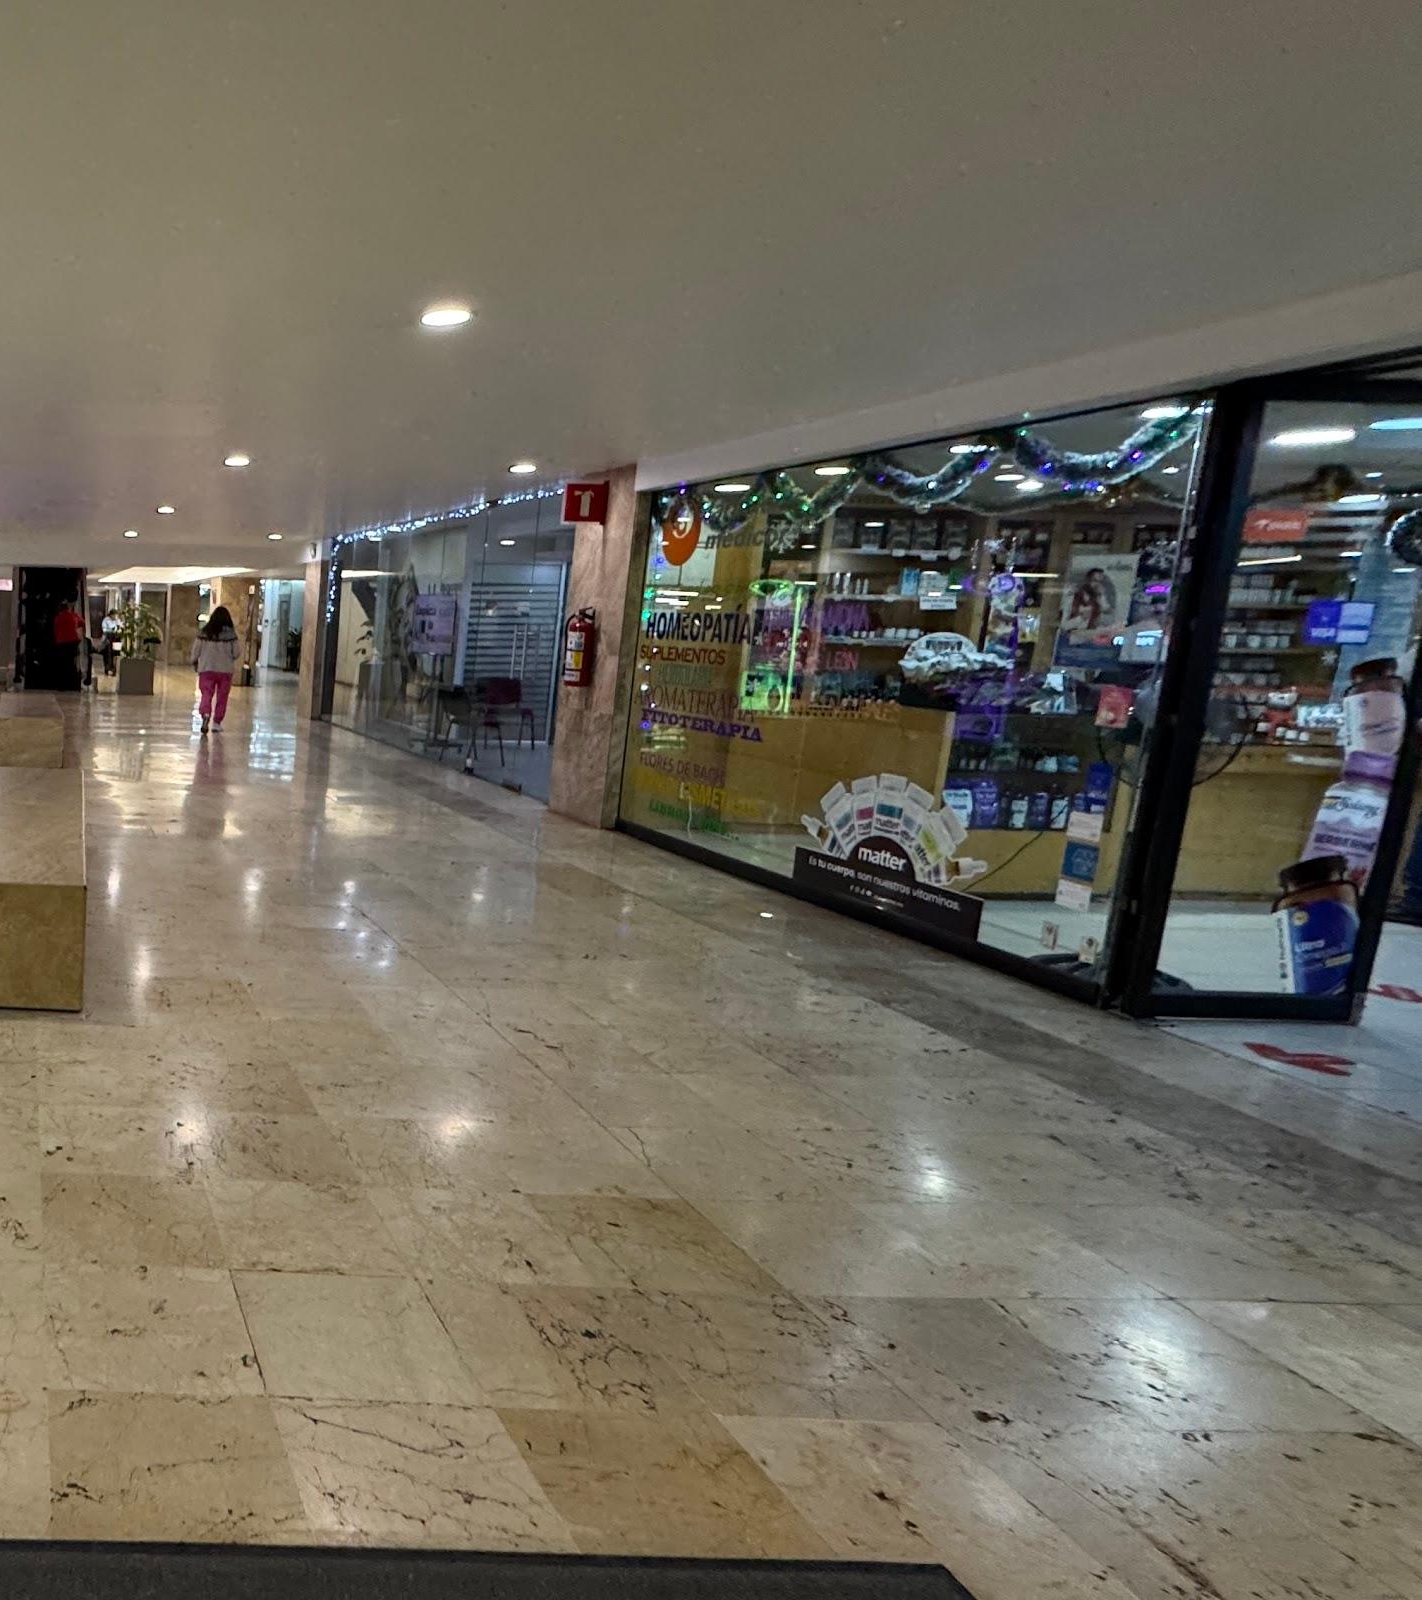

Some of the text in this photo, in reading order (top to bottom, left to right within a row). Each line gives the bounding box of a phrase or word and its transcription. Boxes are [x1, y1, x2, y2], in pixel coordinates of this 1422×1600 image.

[645, 604, 752, 644] HOMEOPATÍA
[640, 644, 726, 665] SUPLEMENTOS
[818, 858, 827, 869] tu
[857, 871, 873, 883] son
[858, 846, 908, 872] matter
